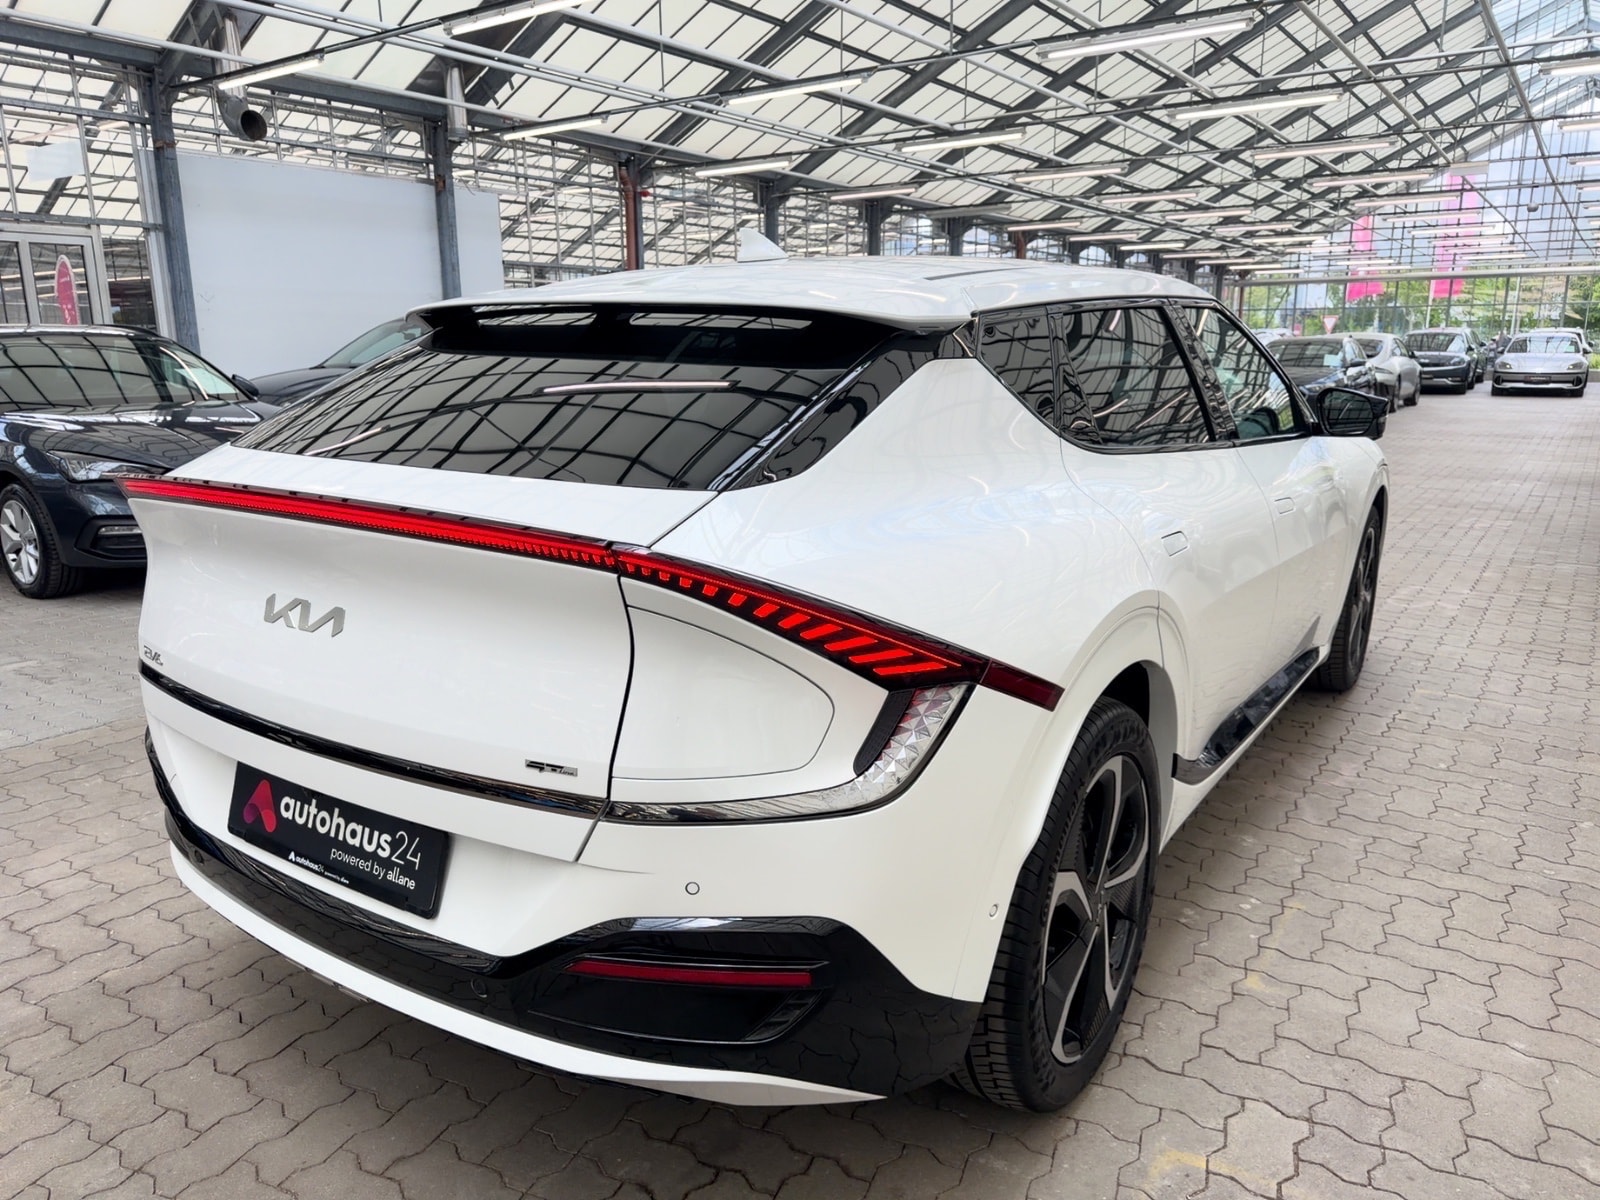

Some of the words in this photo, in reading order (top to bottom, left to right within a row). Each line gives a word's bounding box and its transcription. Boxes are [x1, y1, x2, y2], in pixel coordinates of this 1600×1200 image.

[264, 593, 346, 637] KIA
[280, 796, 421, 870] autohaus24
[330, 848, 371, 871] powered
[373, 862, 385, 880] by
[386, 866, 416, 890] allane
